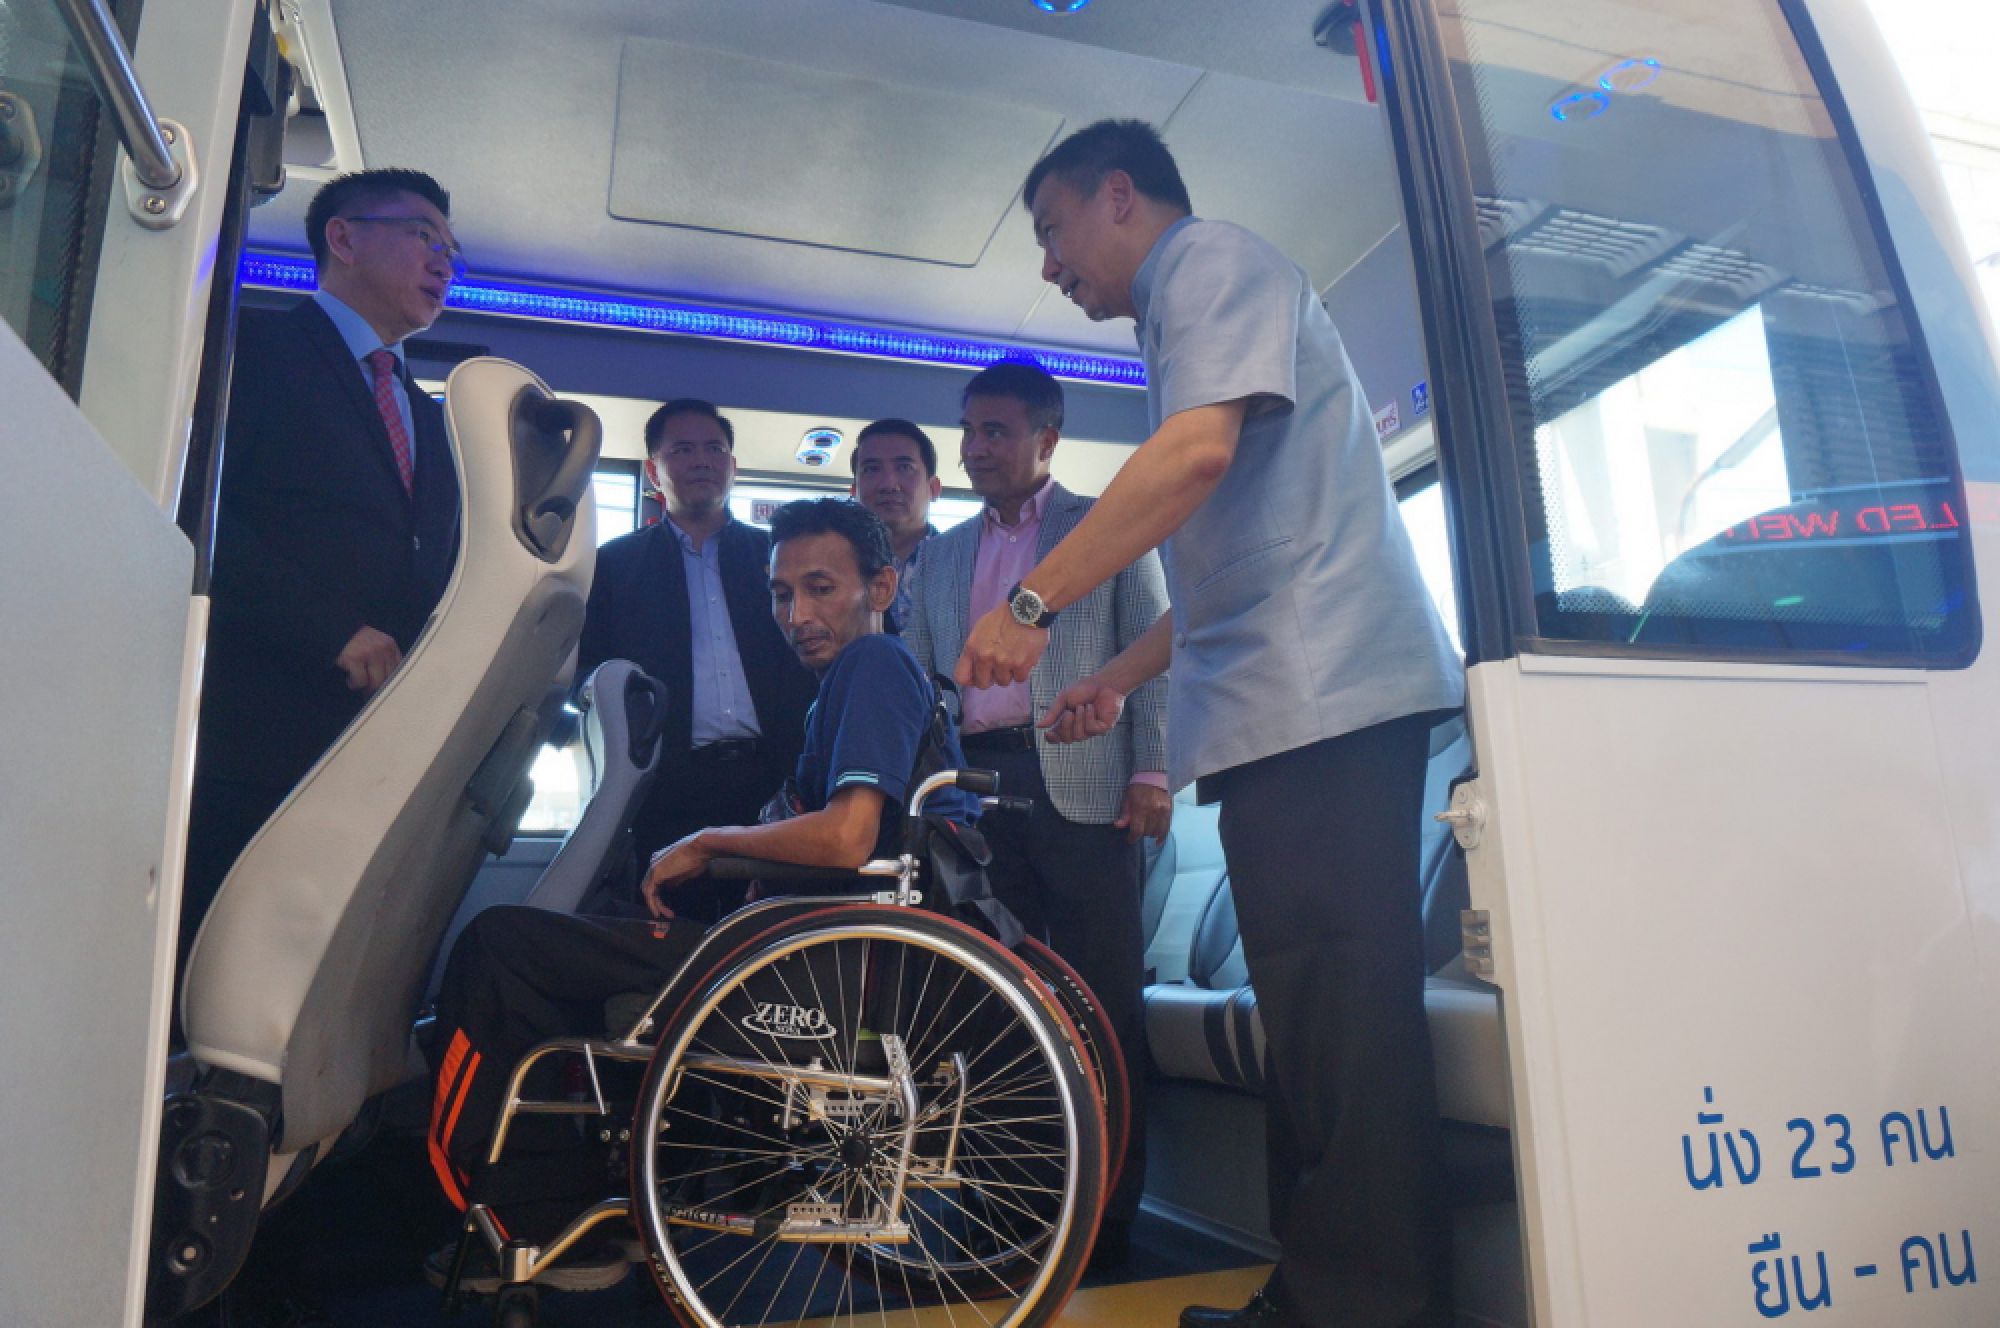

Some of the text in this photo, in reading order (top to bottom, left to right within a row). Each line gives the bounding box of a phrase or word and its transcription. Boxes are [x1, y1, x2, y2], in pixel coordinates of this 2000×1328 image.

[756, 1001, 827, 1029] ZERO
[1681, 1086, 1955, 1190] นั่ง 23 คน
[1748, 1231, 1833, 1319] ยืน
[1900, 1229, 1977, 1293] คน
